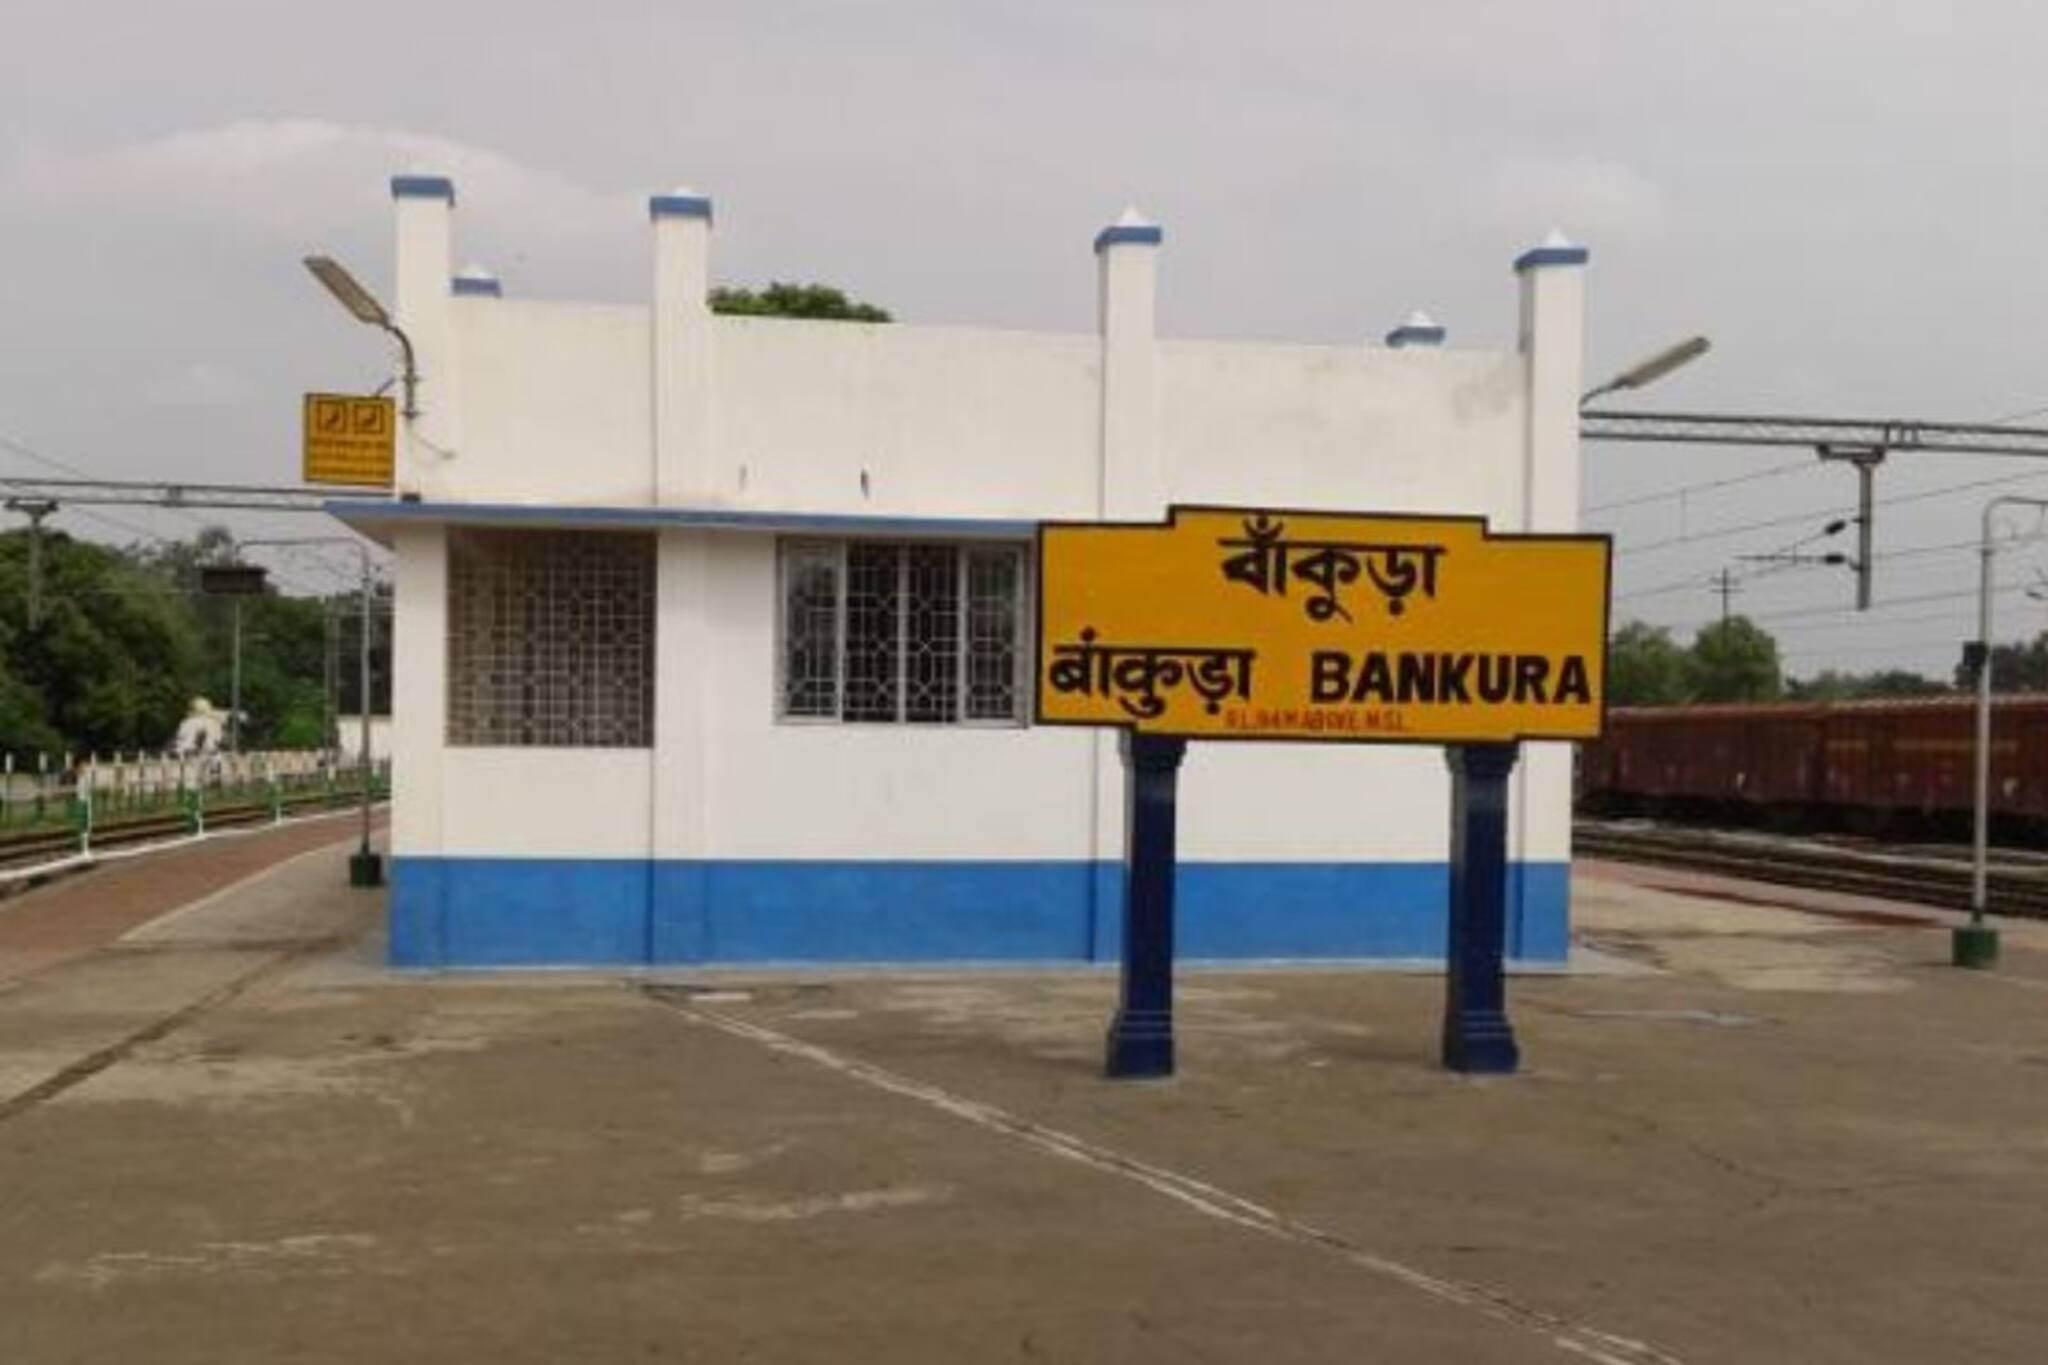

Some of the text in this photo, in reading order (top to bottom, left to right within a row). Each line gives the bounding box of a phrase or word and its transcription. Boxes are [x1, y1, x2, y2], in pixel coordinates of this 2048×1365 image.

[1217, 516, 1447, 623] বাঁকুড়া
[1049, 627, 1256, 718] बांकुड़ा
[1312, 651, 1591, 704] BANKURA
